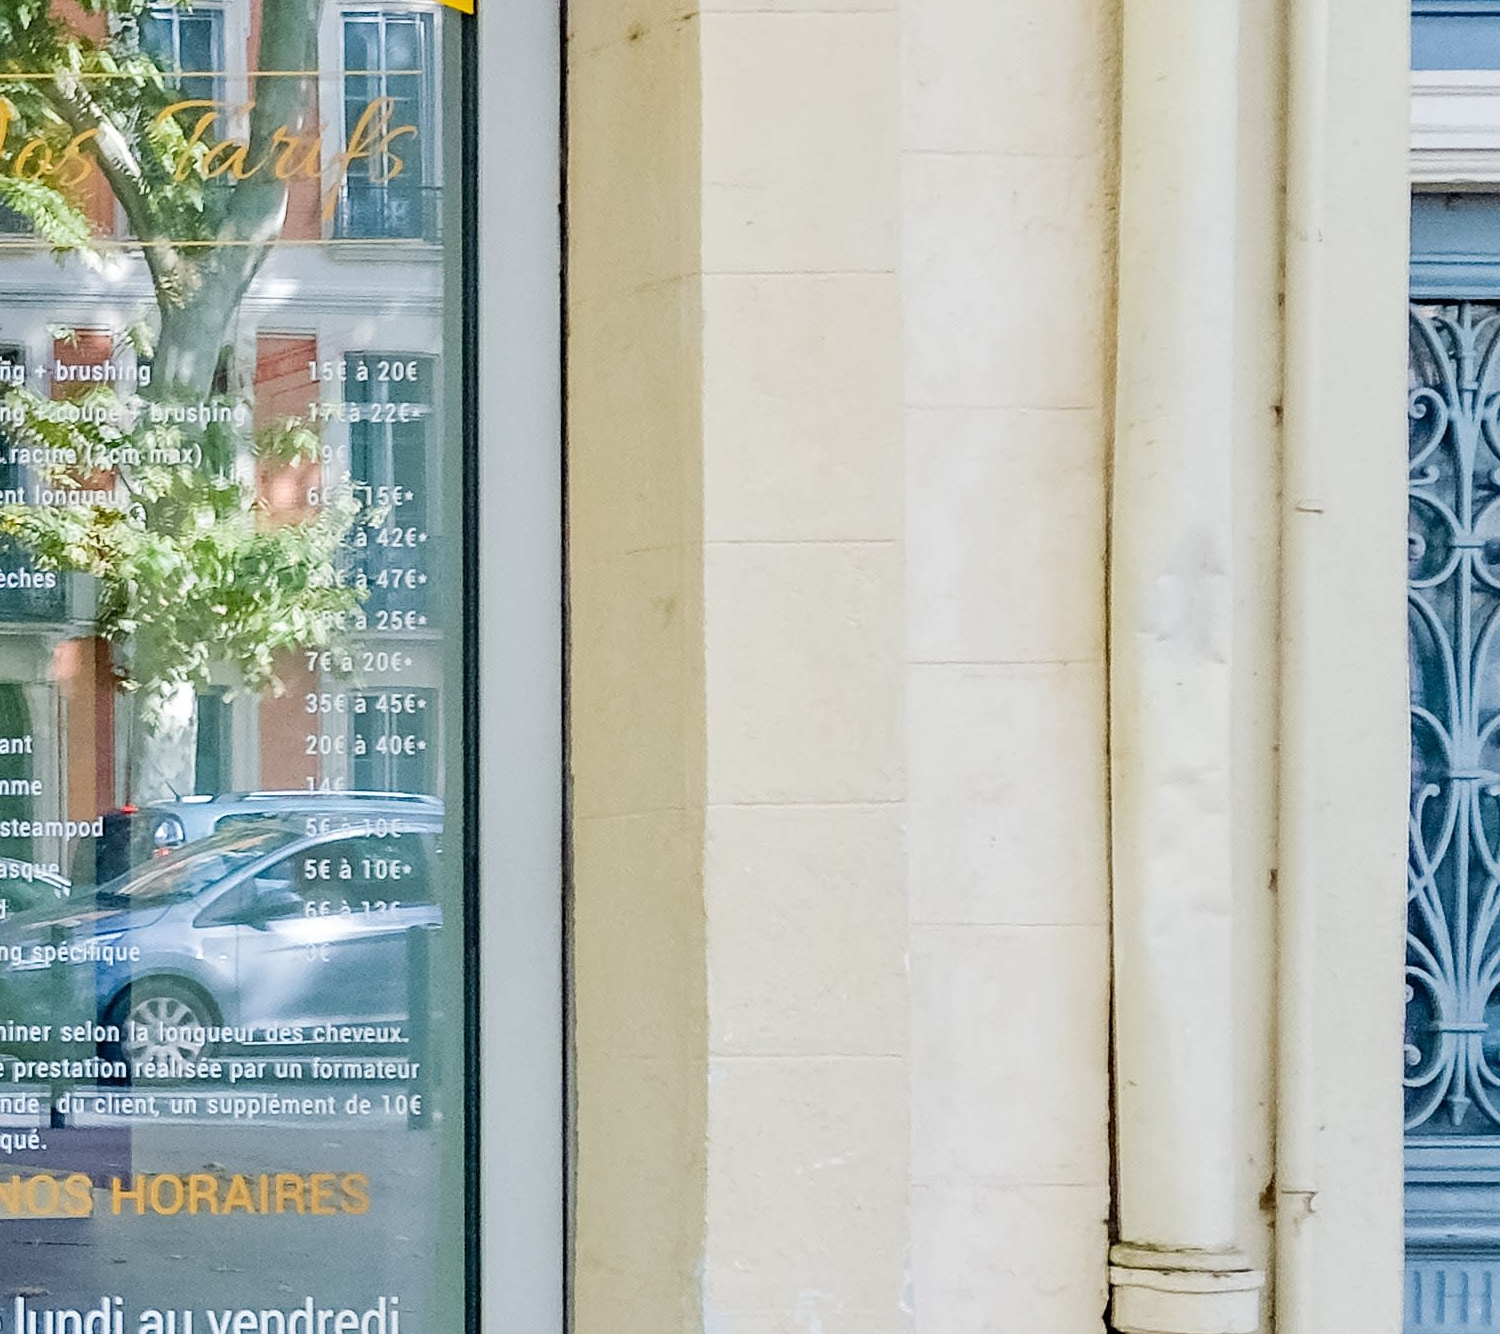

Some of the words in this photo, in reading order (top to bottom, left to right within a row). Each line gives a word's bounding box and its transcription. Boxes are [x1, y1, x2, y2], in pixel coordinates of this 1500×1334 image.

[152, 95, 418, 221] Tarifs
[55, 360, 152, 385] brushing
[308, 361, 347, 381] 15€
[355, 360, 369, 381] à
[377, 361, 418, 381] 20€
[55, 403, 119, 426] coupe
[150, 401, 246, 426] brushing
[349, 402, 360, 422] à
[9, 444, 78, 465] racine
[149, 443, 202, 468] max)
[308, 445, 348, 464] 9€
[355, 527, 368, 547] à
[355, 569, 368, 589] à
[305, 651, 332, 673] 7€
[341, 650, 354, 673] à
[305, 693, 347, 715] 35€
[354, 692, 368, 715] à
[305, 734, 347, 756] 20€
[354, 733, 368, 756] à
[0, 816, 104, 844] steampod
[304, 858, 332, 880] 5€
[339, 858, 352, 880] à
[30, 940, 141, 967] spécifique
[59, 1020, 121, 1043] selon
[129, 1020, 149, 1043] la
[158, 1020, 256, 1048] longueur
[265, 1021, 305, 1044] des
[312, 1021, 410, 1044] cheveux.
[13, 1059, 127, 1083] prestation
[135, 1058, 223, 1080] réalisée
[230, 1063, 266, 1085] par
[273, 1063, 302, 1080] un
[311, 1059, 420, 1080] formateur
[58, 1094, 86, 1115] du
[95, 1094, 160, 1119] client,
[171, 1098, 197, 1116] un
[207, 1094, 336, 1119] supplément
[345, 1094, 371, 1116] de
[381, 1095, 422, 1116] 10€
[111, 1172, 371, 1217] HORAIRES
